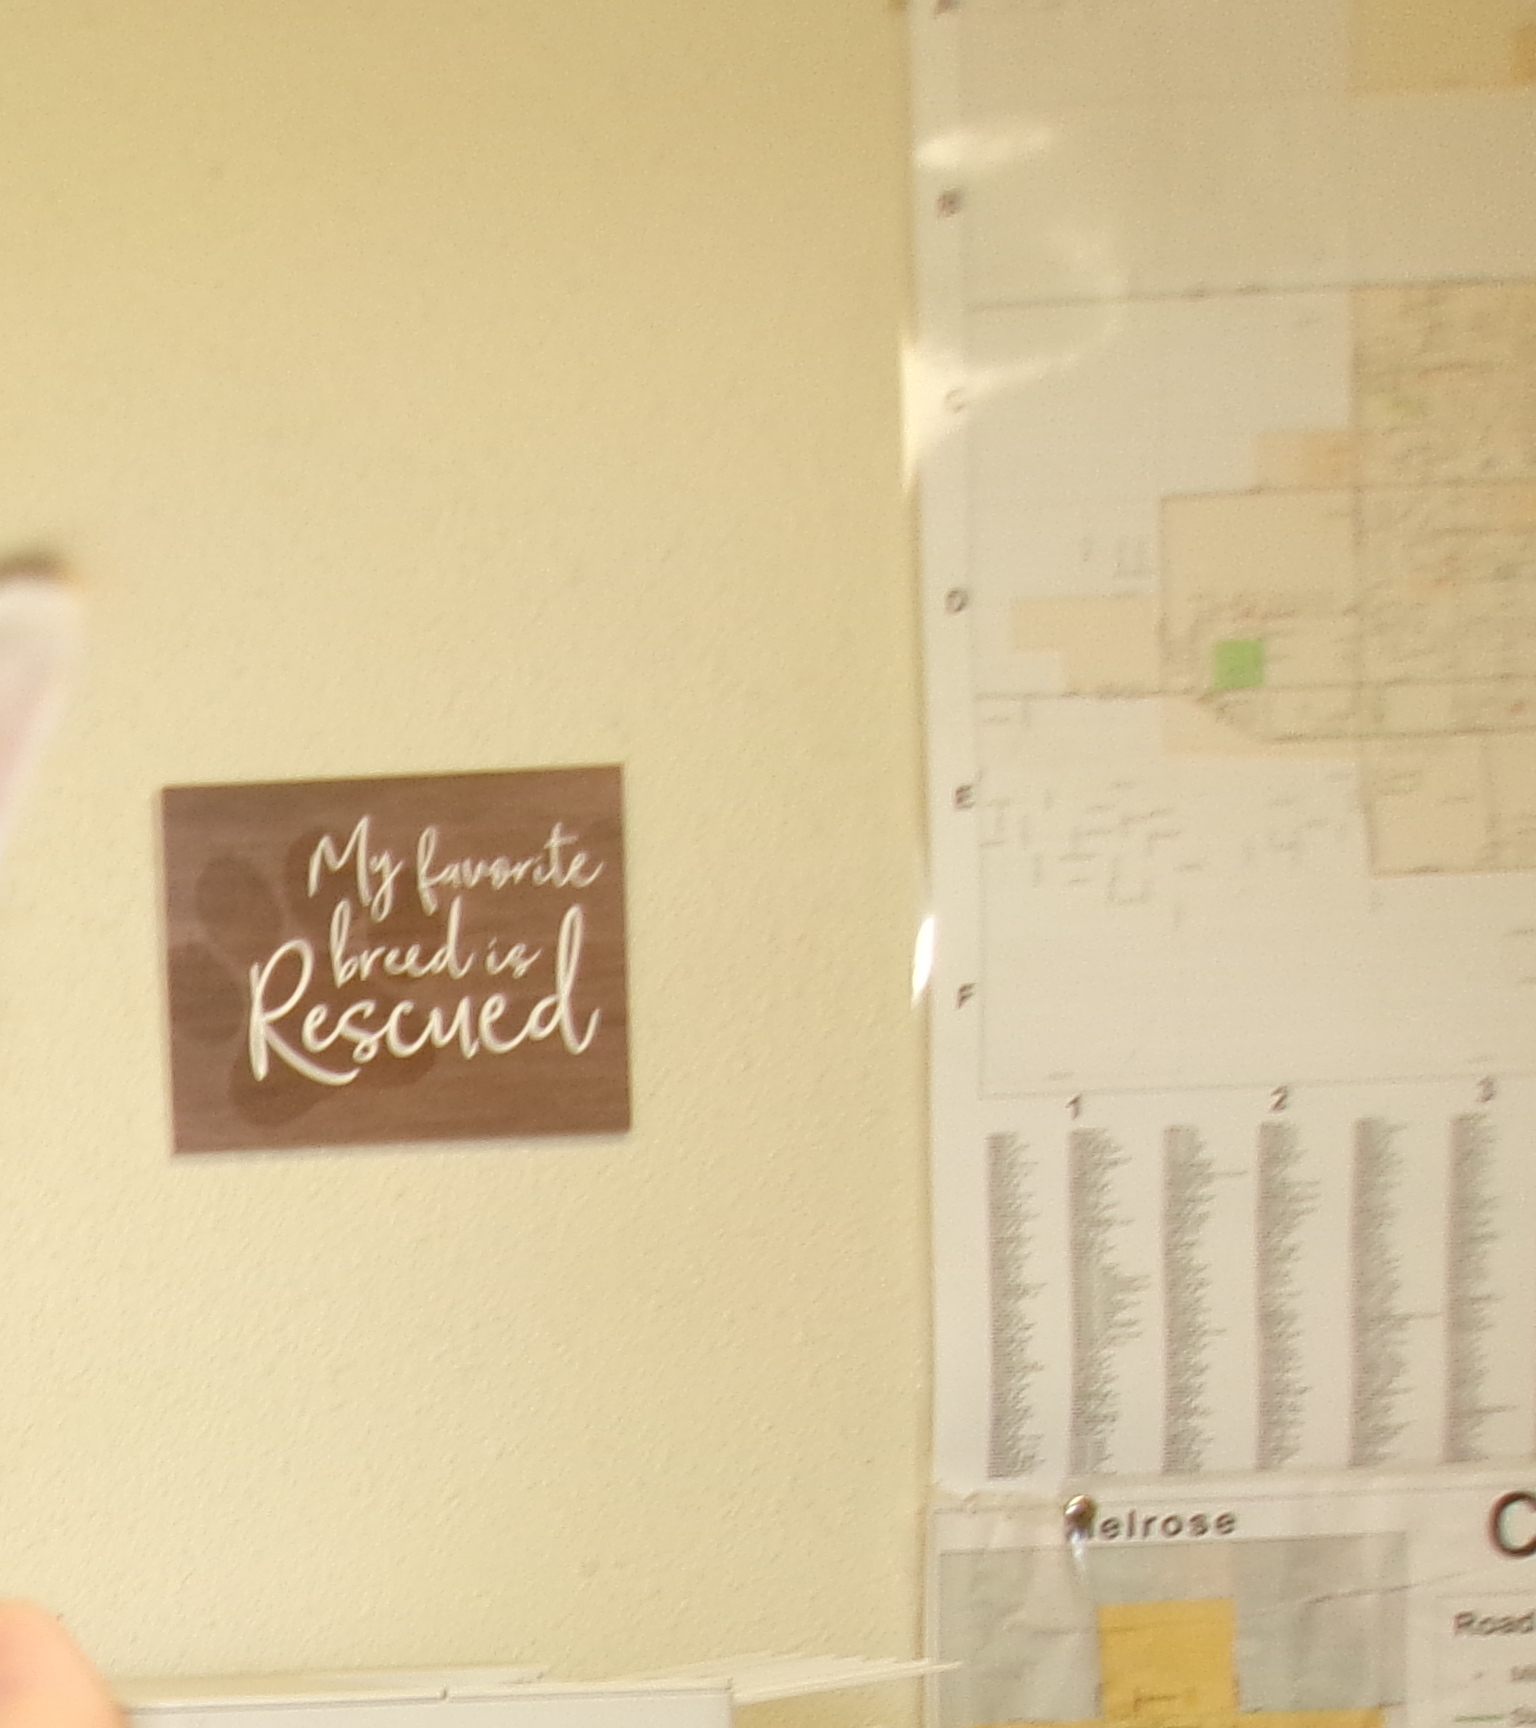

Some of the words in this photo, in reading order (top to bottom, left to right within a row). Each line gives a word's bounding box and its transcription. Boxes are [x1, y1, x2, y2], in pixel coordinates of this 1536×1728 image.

[307, 813, 406, 923] My
[416, 820, 604, 916] favorite
[328, 897, 478, 989] breed
[484, 936, 542, 980] is
[247, 902, 602, 1087] Rescued
[1064, 1093, 1084, 1121] 1
[1269, 1085, 1291, 1113] 2
[1476, 1075, 1499, 1104] 3
